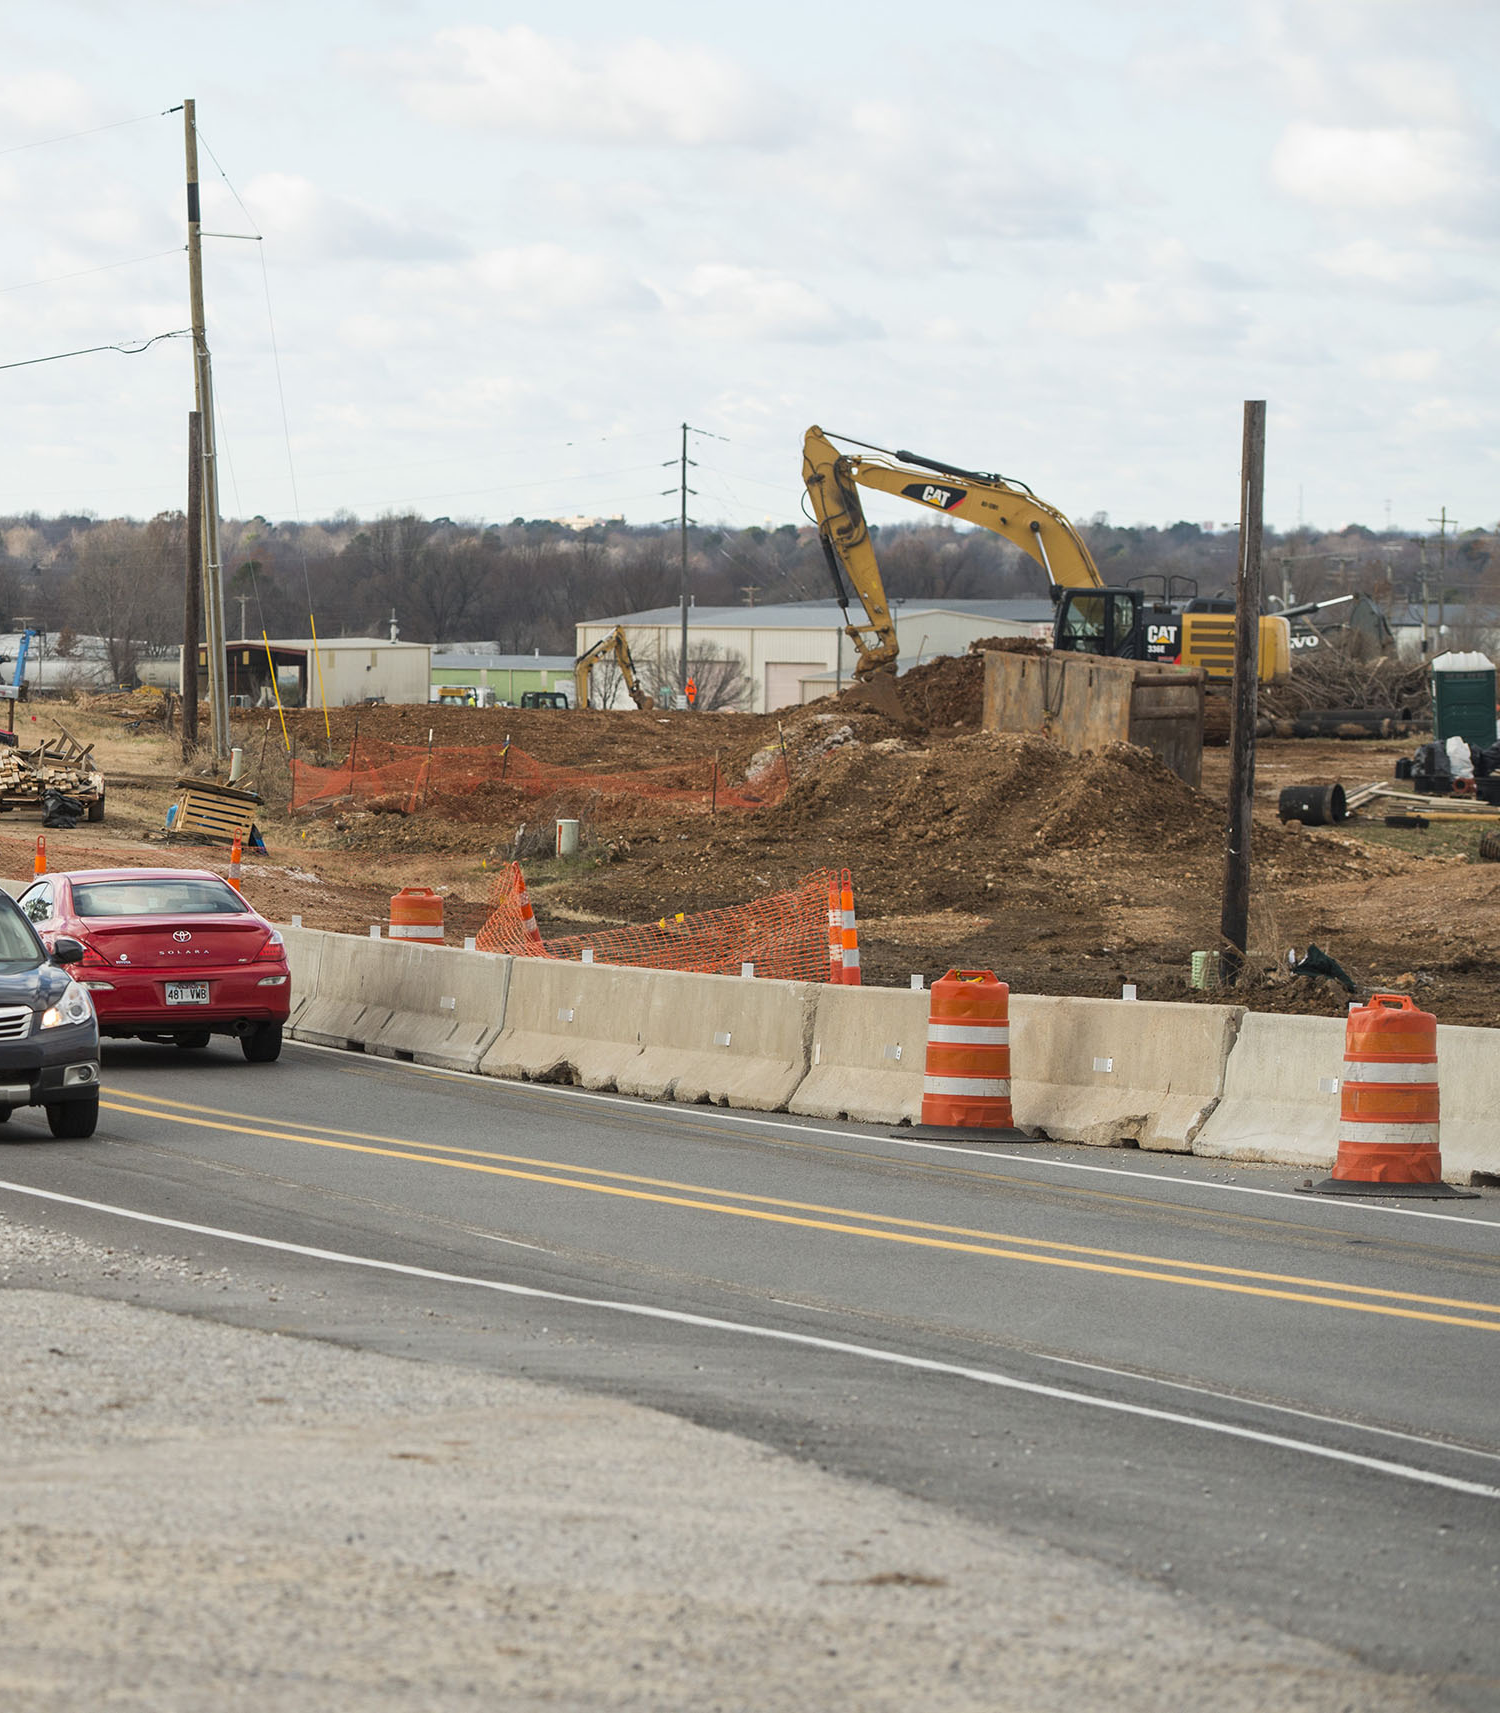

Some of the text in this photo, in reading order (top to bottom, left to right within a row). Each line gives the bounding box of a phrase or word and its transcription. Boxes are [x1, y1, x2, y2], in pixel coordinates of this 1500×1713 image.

[922, 486, 951, 507] CAT
[1147, 625, 1178, 644] CAT
[1290, 635, 1319, 649] VO
[168, 989, 207, 1000] 481 VWB
